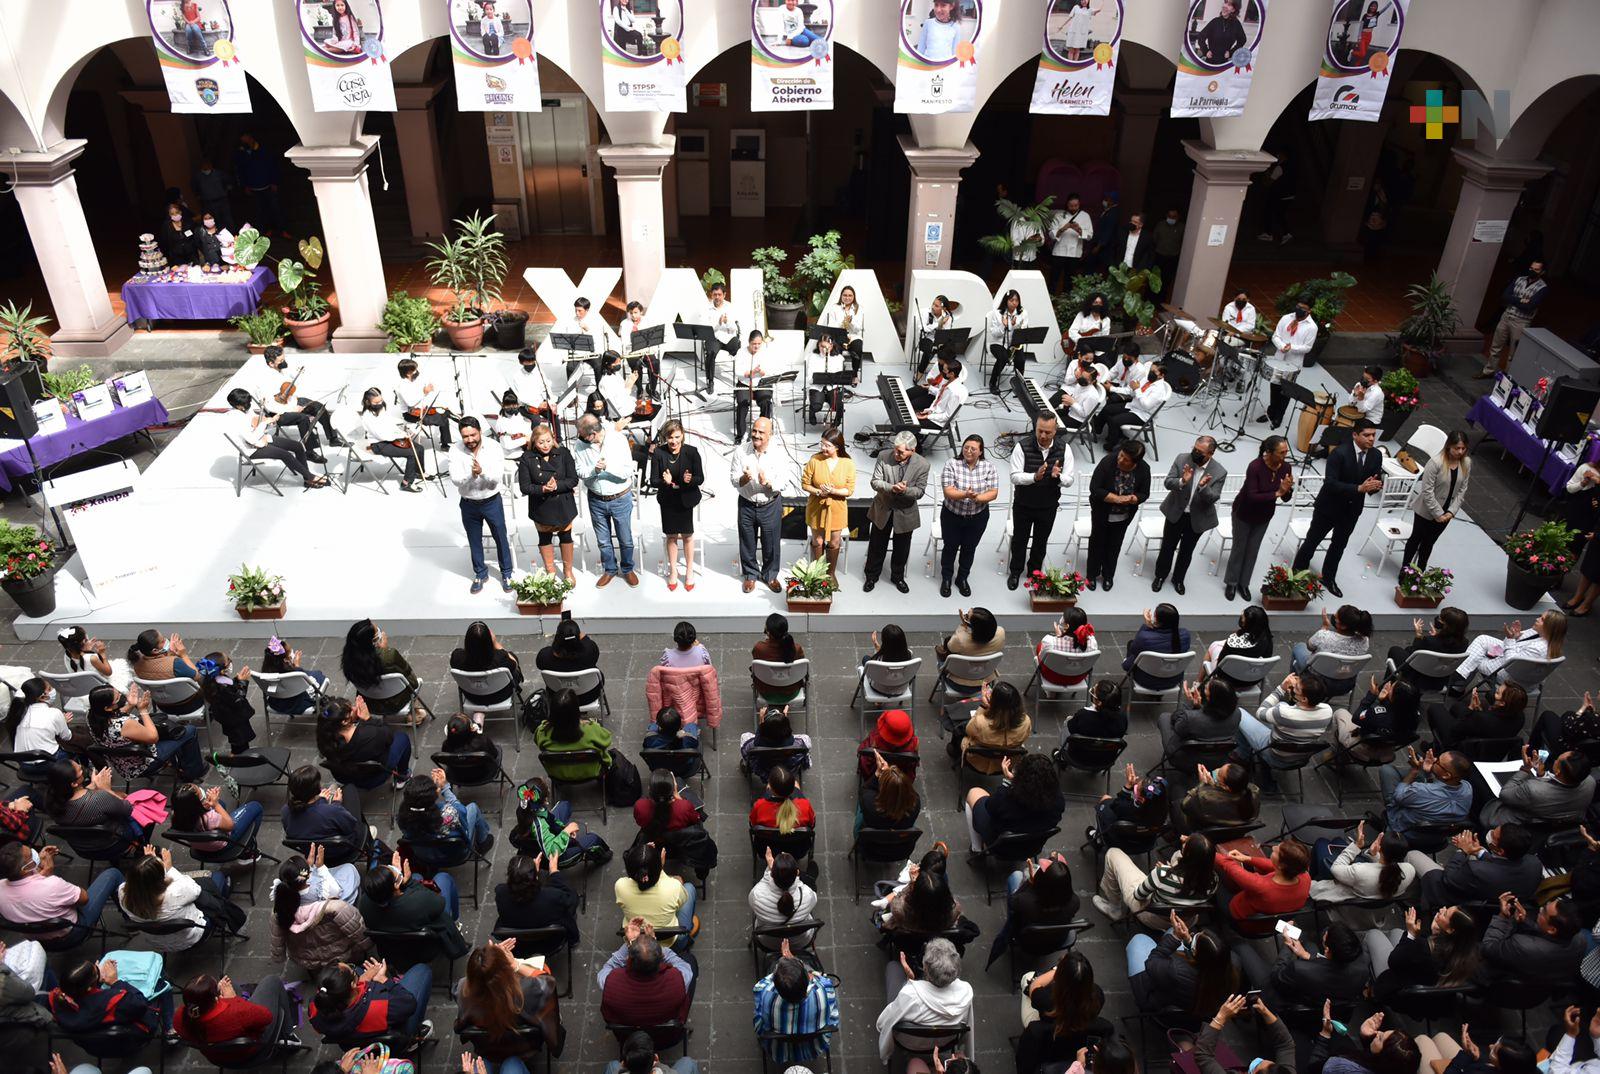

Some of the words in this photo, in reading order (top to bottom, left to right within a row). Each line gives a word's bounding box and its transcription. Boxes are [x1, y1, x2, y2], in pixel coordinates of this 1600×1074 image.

[772, 85, 822, 95] Gobierno
[1051, 79, 1095, 102] Helen
[772, 95, 813, 104] Abierto
[1190, 96, 1199, 106] La
[1199, 96, 1229, 107] Parroquia
[89, 491, 130, 507] Xalapa
